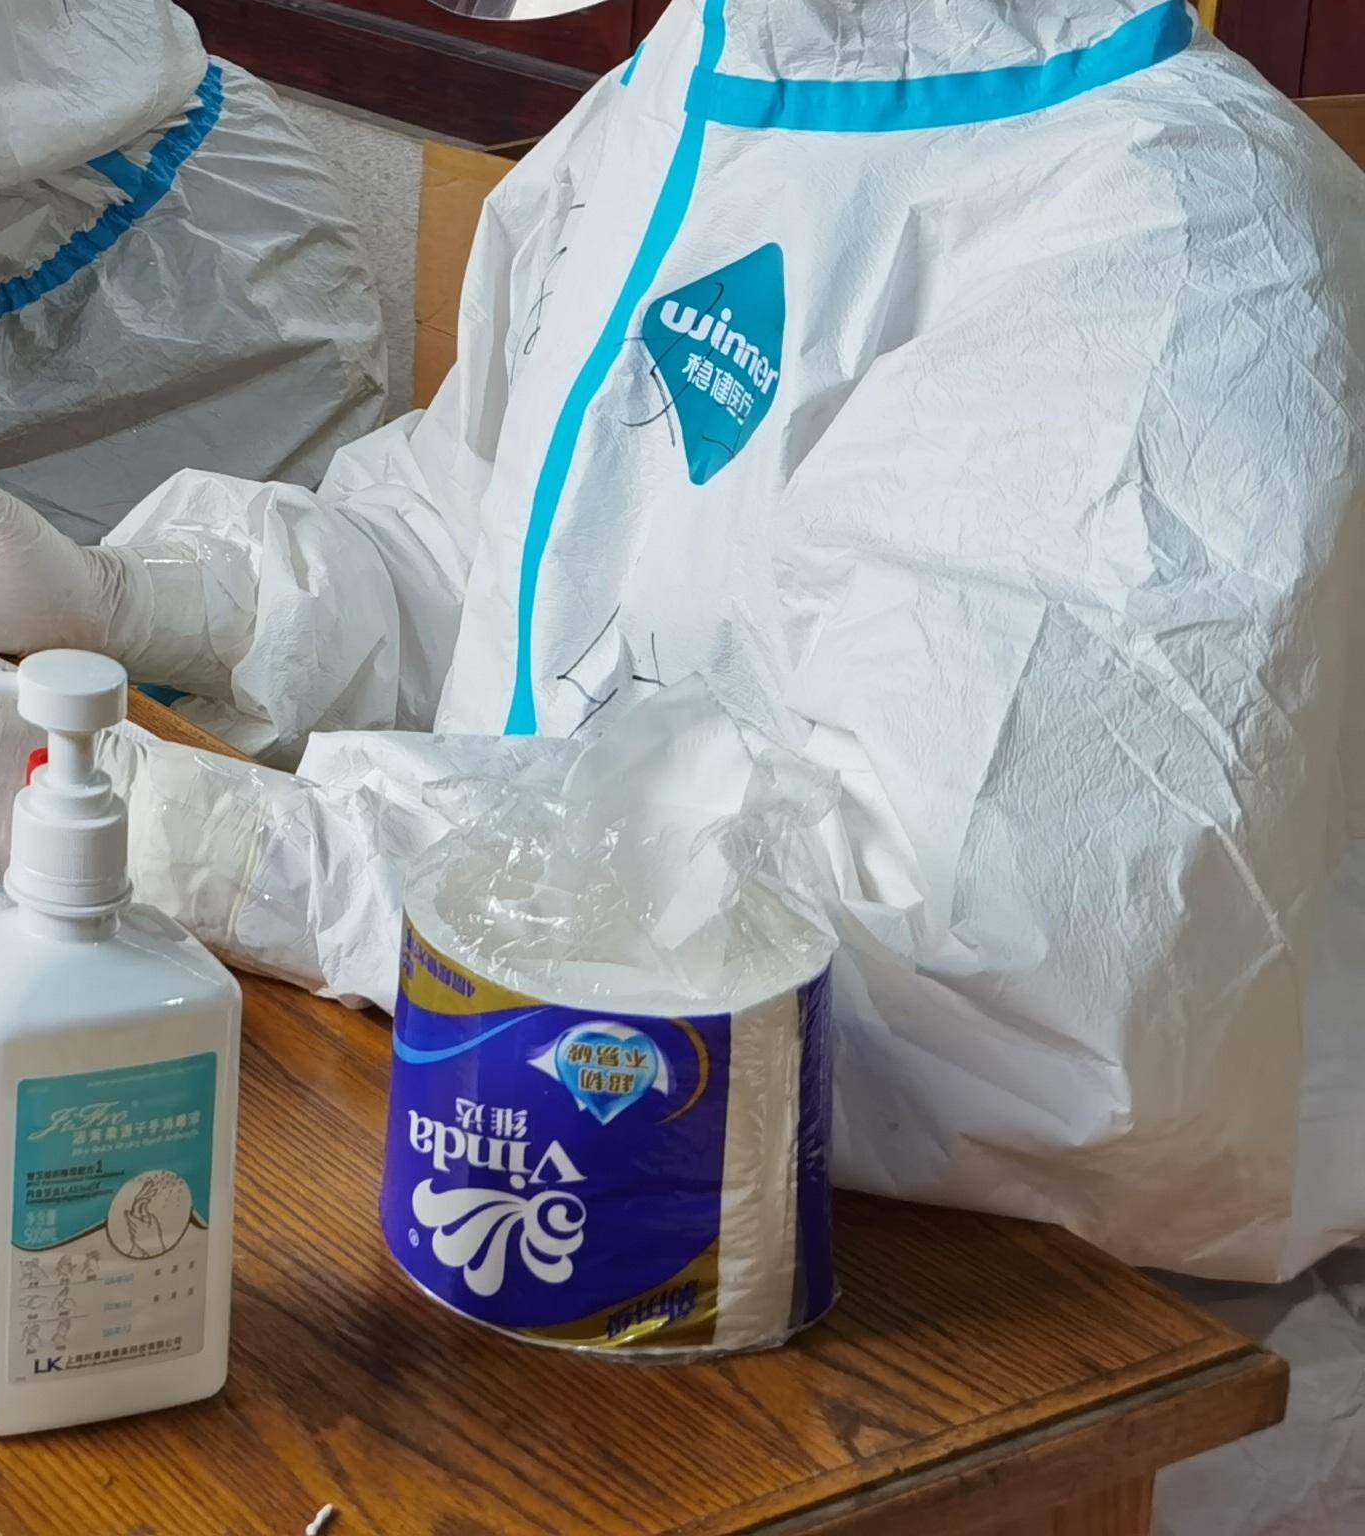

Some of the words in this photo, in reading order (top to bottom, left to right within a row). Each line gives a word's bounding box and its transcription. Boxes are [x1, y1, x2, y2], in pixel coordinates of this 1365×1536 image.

[659, 299, 778, 395] winner
[682, 351, 755, 426] 稳健医疗
[567, 1040, 650, 1071] 不易破
[578, 1066, 636, 1096] 超韧
[455, 1096, 529, 1139] 维达
[407, 1109, 588, 1191] Vinda
[33, 1356, 65, 1375] LK
